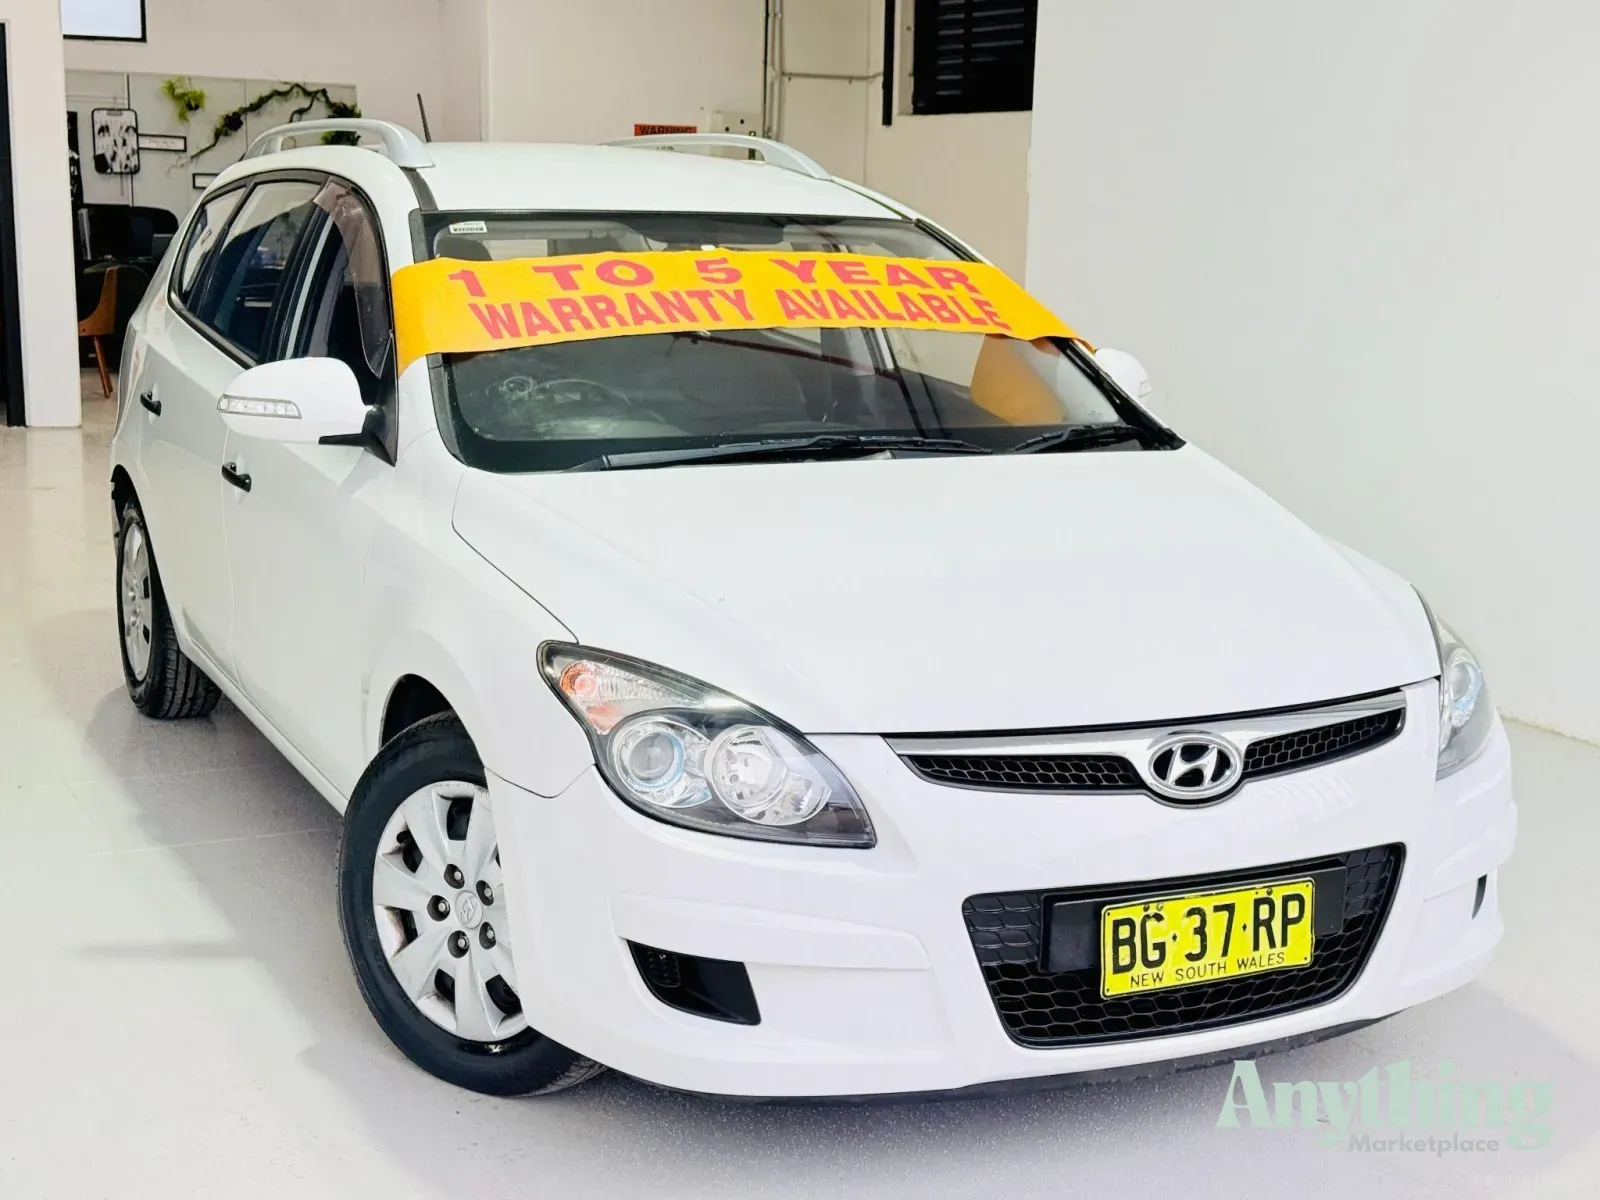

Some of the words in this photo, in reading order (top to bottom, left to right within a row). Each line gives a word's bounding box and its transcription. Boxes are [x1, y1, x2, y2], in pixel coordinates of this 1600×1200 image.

[448, 269, 487, 297] 1
[532, 259, 655, 291] TO
[695, 257, 743, 285] 5
[768, 258, 982, 295] YEAR
[468, 289, 756, 341] WARRANTY
[775, 288, 1013, 331] AVAILABLE
[1130, 971, 1165, 988] NEW
[1175, 961, 1227, 982] SOUTH
[1236, 951, 1285, 969] WALES
